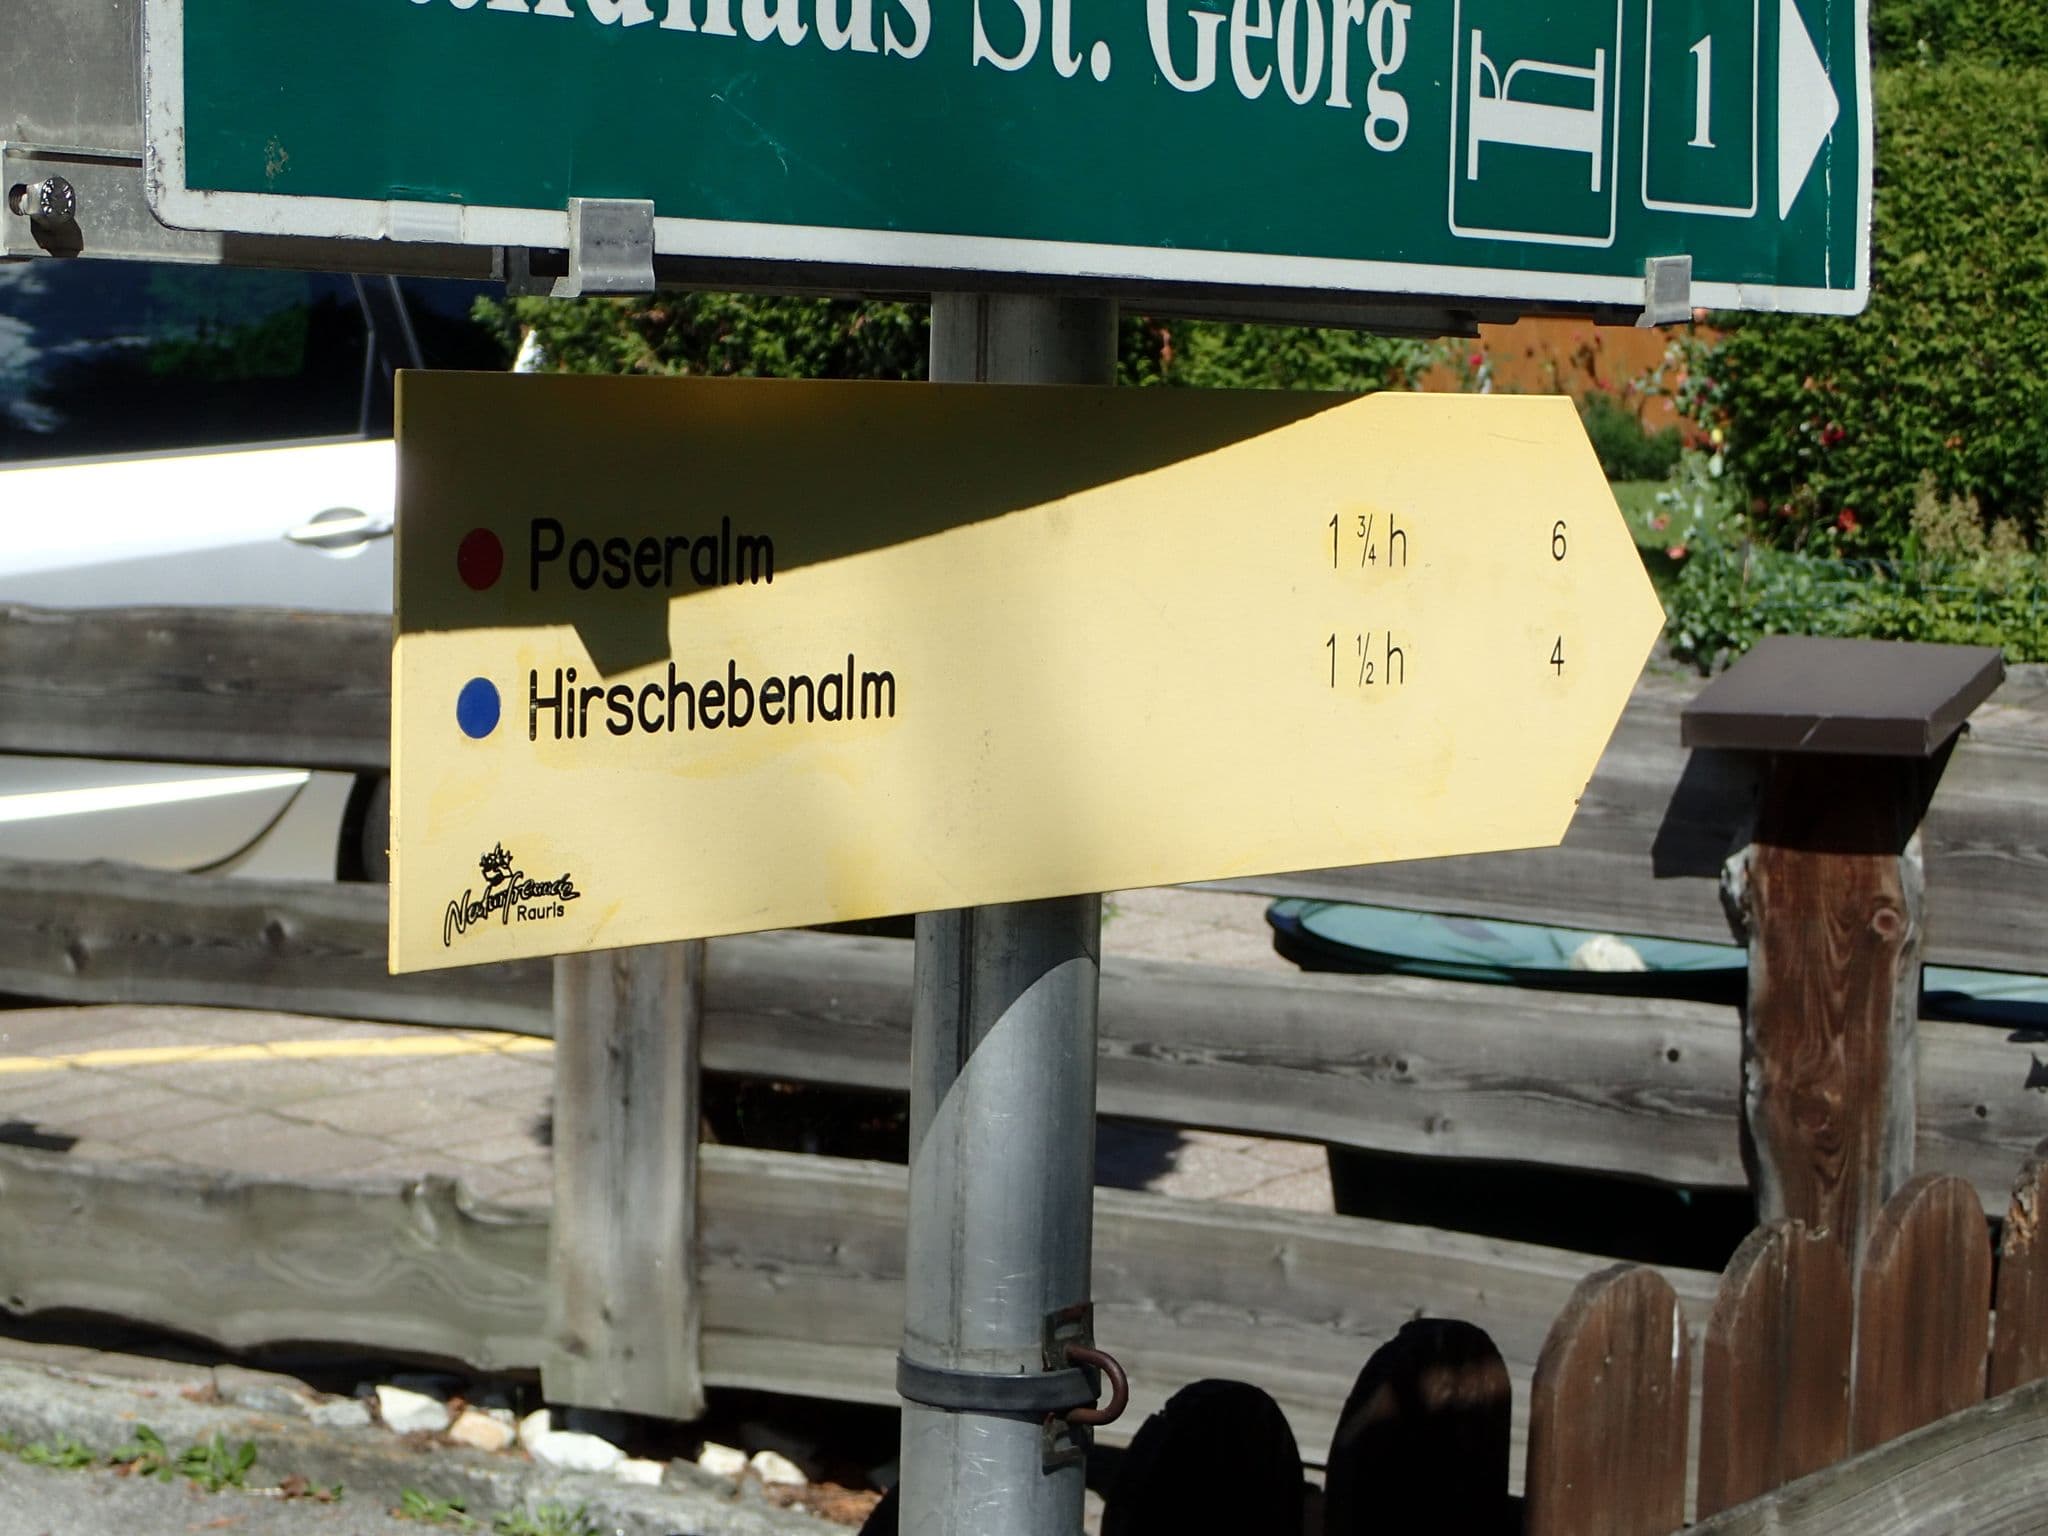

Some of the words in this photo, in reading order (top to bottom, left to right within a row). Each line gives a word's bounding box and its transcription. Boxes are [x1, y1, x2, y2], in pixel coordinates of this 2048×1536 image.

[1146, 0, 1411, 152] Georg
[1687, 34, 1716, 148] 1
[530, 515, 774, 591] Poseralm
[1328, 512, 1339, 569] 1
[1551, 519, 1567, 562] 6
[529, 653, 896, 741] Hirschebenalm
[1326, 632, 1336, 688] 1
[1550, 634, 1565, 676] 4
[516, 901, 565, 922] Rauris
